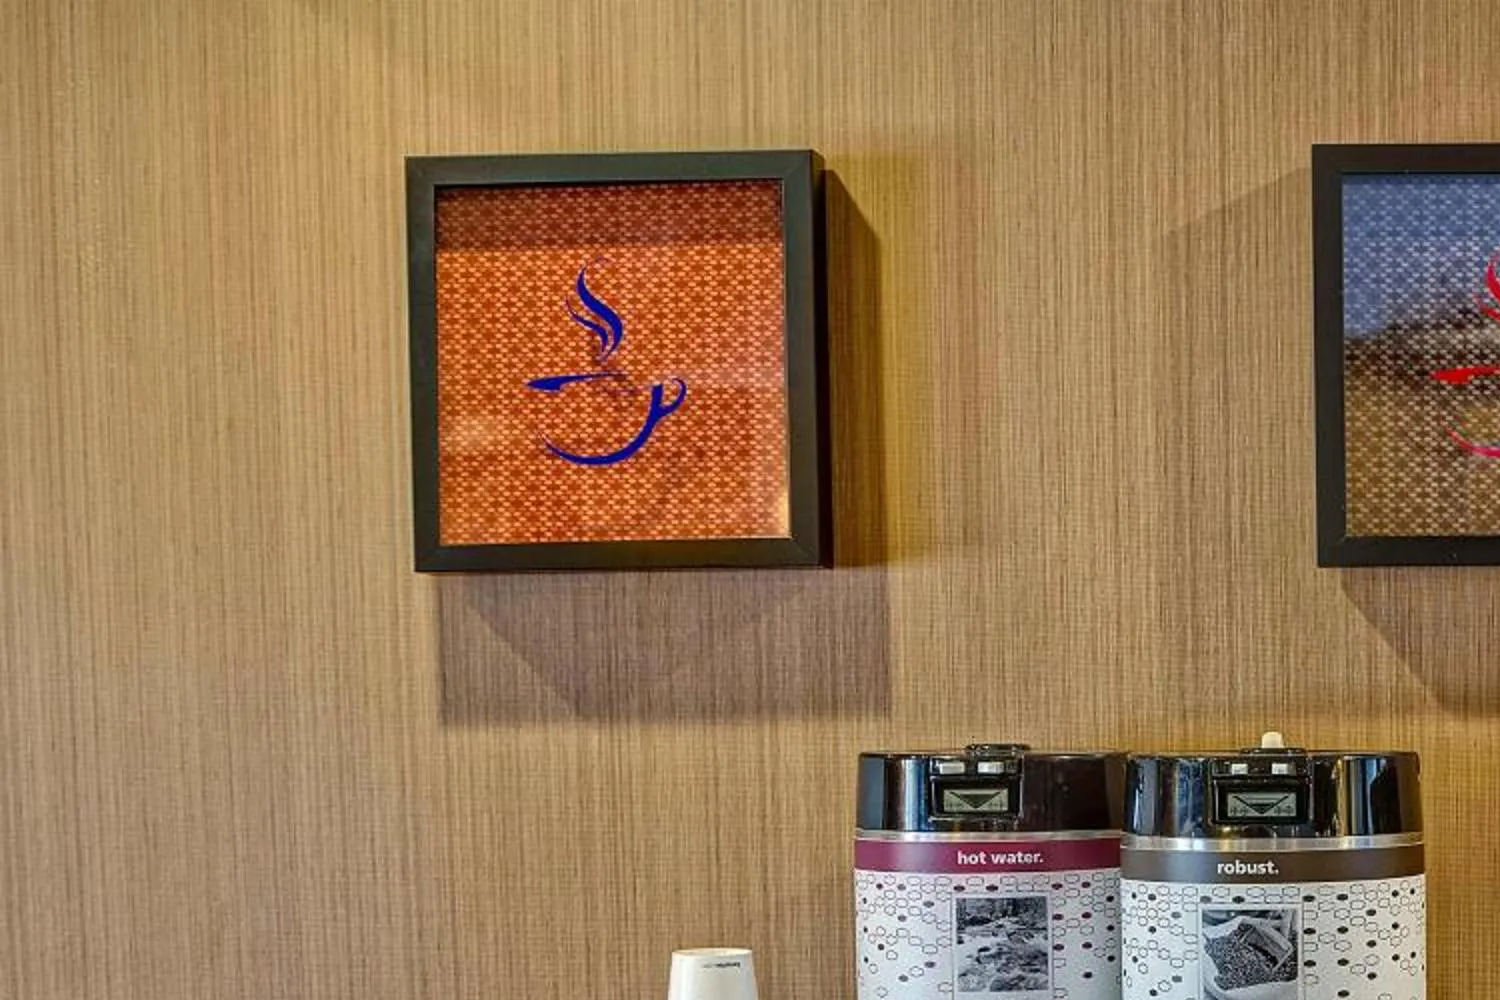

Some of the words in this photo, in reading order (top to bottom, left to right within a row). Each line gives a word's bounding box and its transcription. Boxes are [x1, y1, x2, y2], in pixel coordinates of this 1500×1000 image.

[957, 850, 987, 865] hot
[991, 851, 1044, 864] water.
[1217, 859, 1279, 875] robust.
